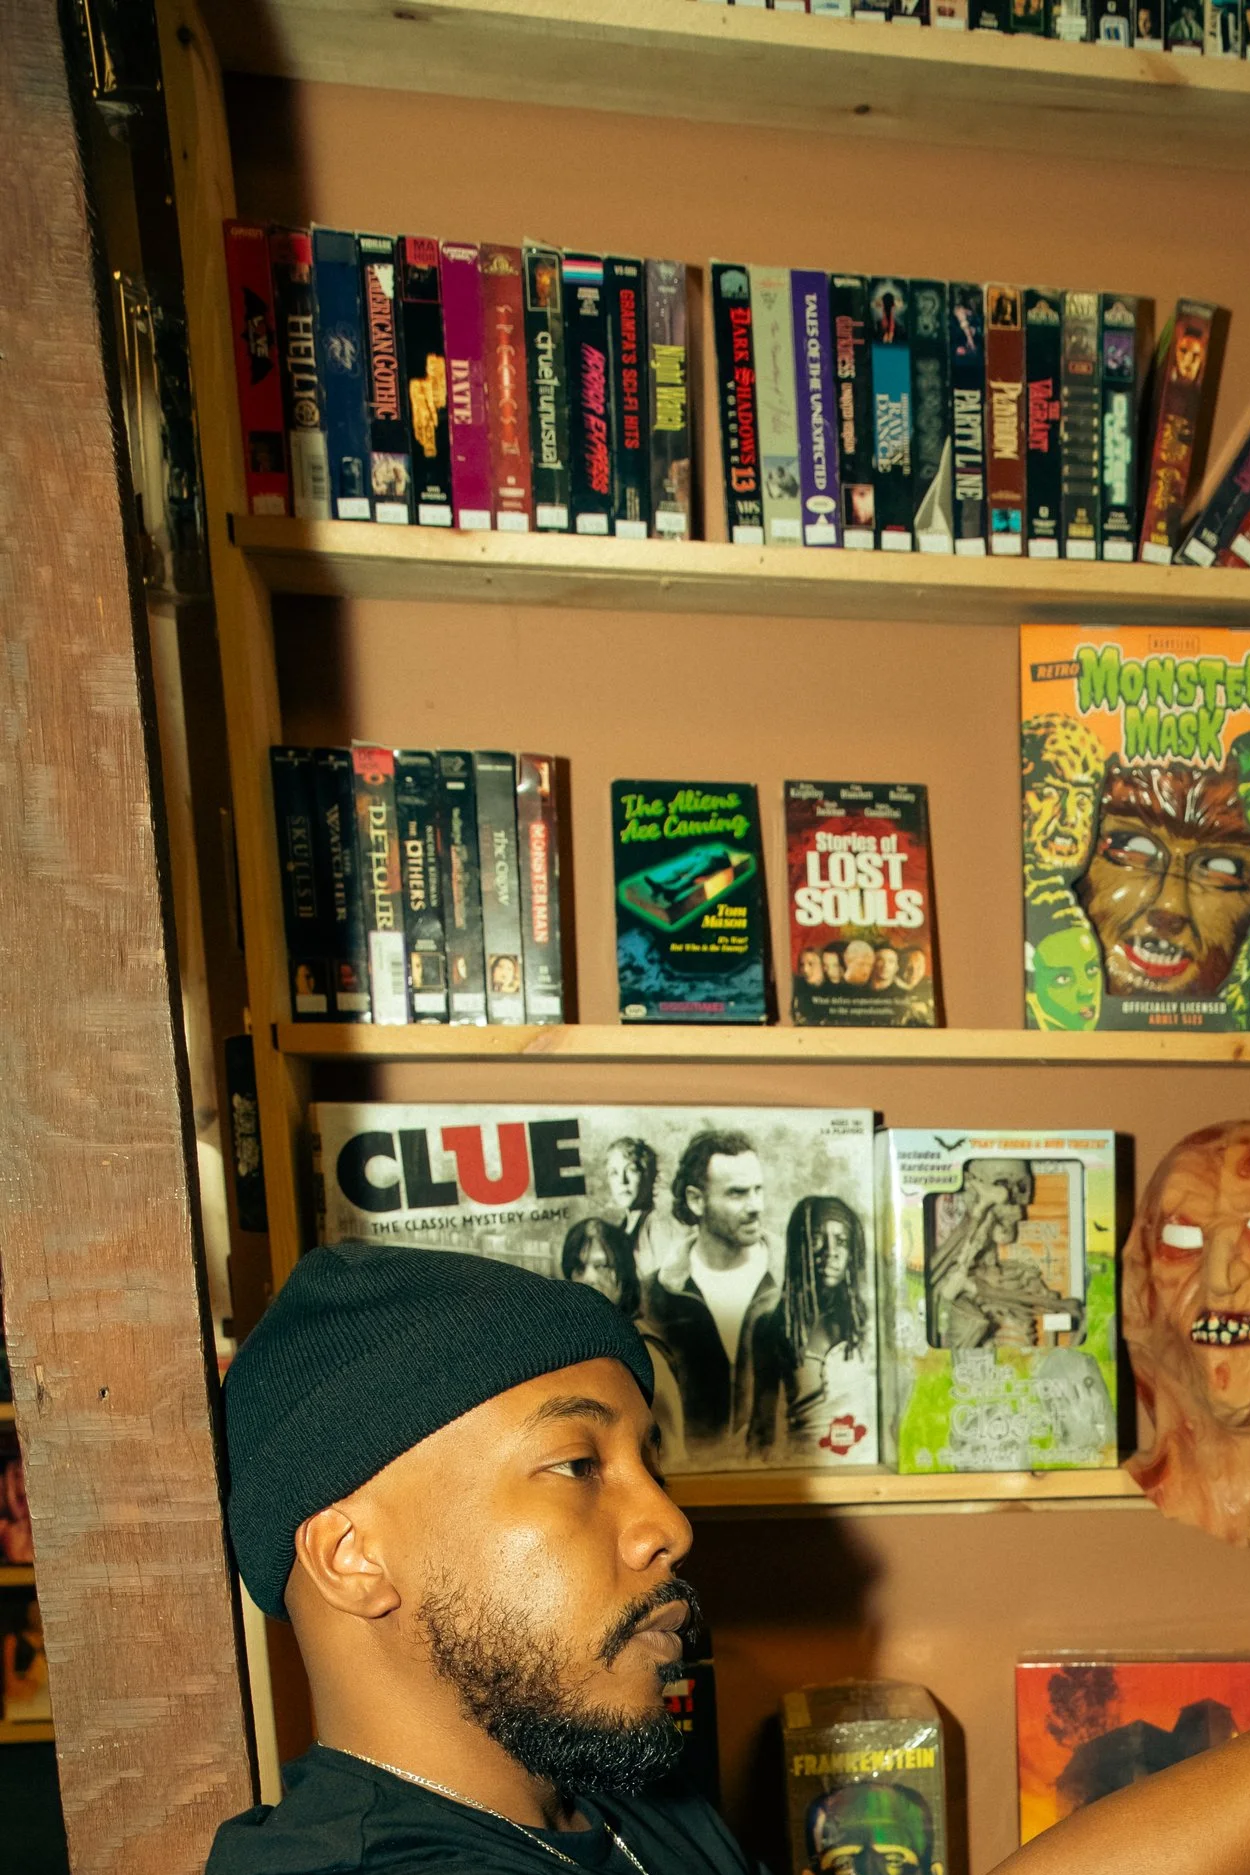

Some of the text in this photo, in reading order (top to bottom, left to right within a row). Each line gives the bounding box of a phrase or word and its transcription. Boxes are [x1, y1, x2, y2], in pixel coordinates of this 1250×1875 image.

[619, 288, 638, 365] GRAMPA'S
[835, 315, 865, 380] darkness
[370, 354, 399, 421] GOTHIC
[450, 358, 473, 426] DATE
[581, 342, 606, 416] HORROR
[621, 370, 639, 413] SCI-FI
[650, 343, 687, 432] Night Watch
[729, 306, 757, 494] DARK SHADOWS 13
[804, 292, 829, 491] TALES OF THE UNEXPECTED
[538, 395, 564, 471] unusual
[623, 415, 640, 450] HITS
[726, 380, 741, 466] VOLUME
[875, 393, 893, 474] DANCE
[887, 400, 904, 467] RAVEN
[954, 388, 984, 501] PARTY LINE
[1028, 379, 1053, 453] VAGRANT
[584, 414, 609, 495] EXPRESS
[1035, 662, 1080, 681] RETRO
[1124, 705, 1227, 764] MASK
[620, 812, 750, 844] Are Coming
[621, 790, 742, 820] The Aliens
[291, 815, 314, 898] SKULLS
[325, 803, 347, 923] WATCHER
[367, 801, 394, 930] DETOUR
[805, 851, 909, 890] LOST
[815, 831, 897, 853] Stories of
[404, 840, 426, 912] OTHERS
[495, 862, 511, 907] Crow
[794, 887, 925, 928] SOULS
[701, 914, 747, 930] Mason
[715, 903, 747, 918] Tom
[1122, 1001, 1227, 1015] OFFICIALLY LICENSED
[336, 1118, 587, 1214] CLUE
[900, 1163, 953, 1172] Hardcover
[370, 1207, 571, 1236] THE CLASSIC MYSTERY GAME
[790, 1747, 936, 1778] FRANKENSTEIN
